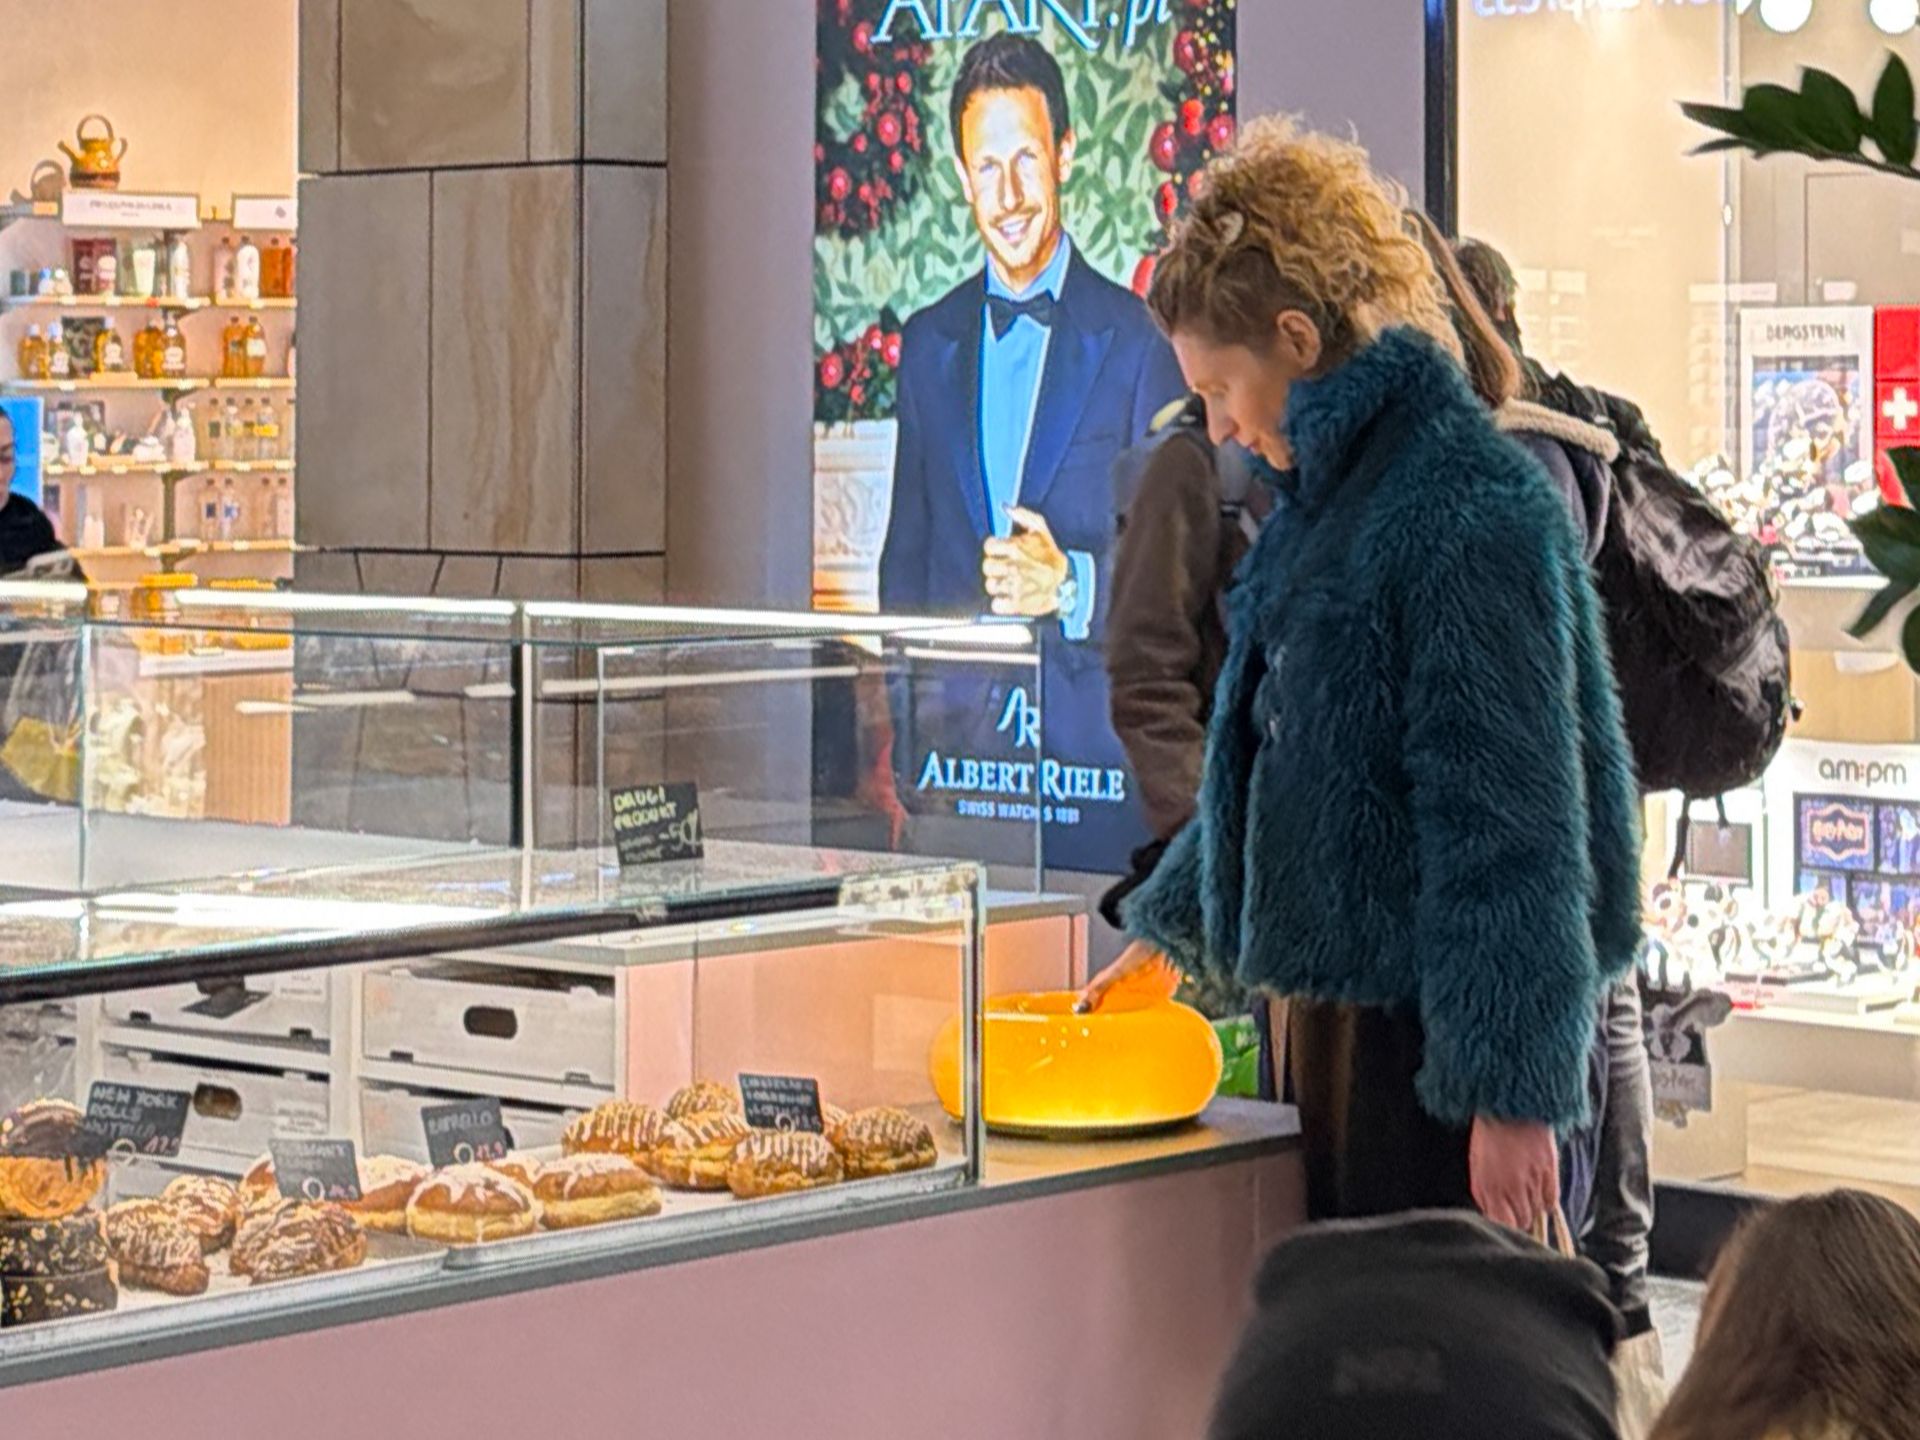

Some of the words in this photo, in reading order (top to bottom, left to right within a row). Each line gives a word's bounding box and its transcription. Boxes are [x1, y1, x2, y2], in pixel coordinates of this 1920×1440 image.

[916, 750, 1035, 795] ALBERT
[1040, 758, 1126, 802] RIELE
[1818, 758, 1907, 787] am:pm
[957, 798, 996, 818] SWISS
